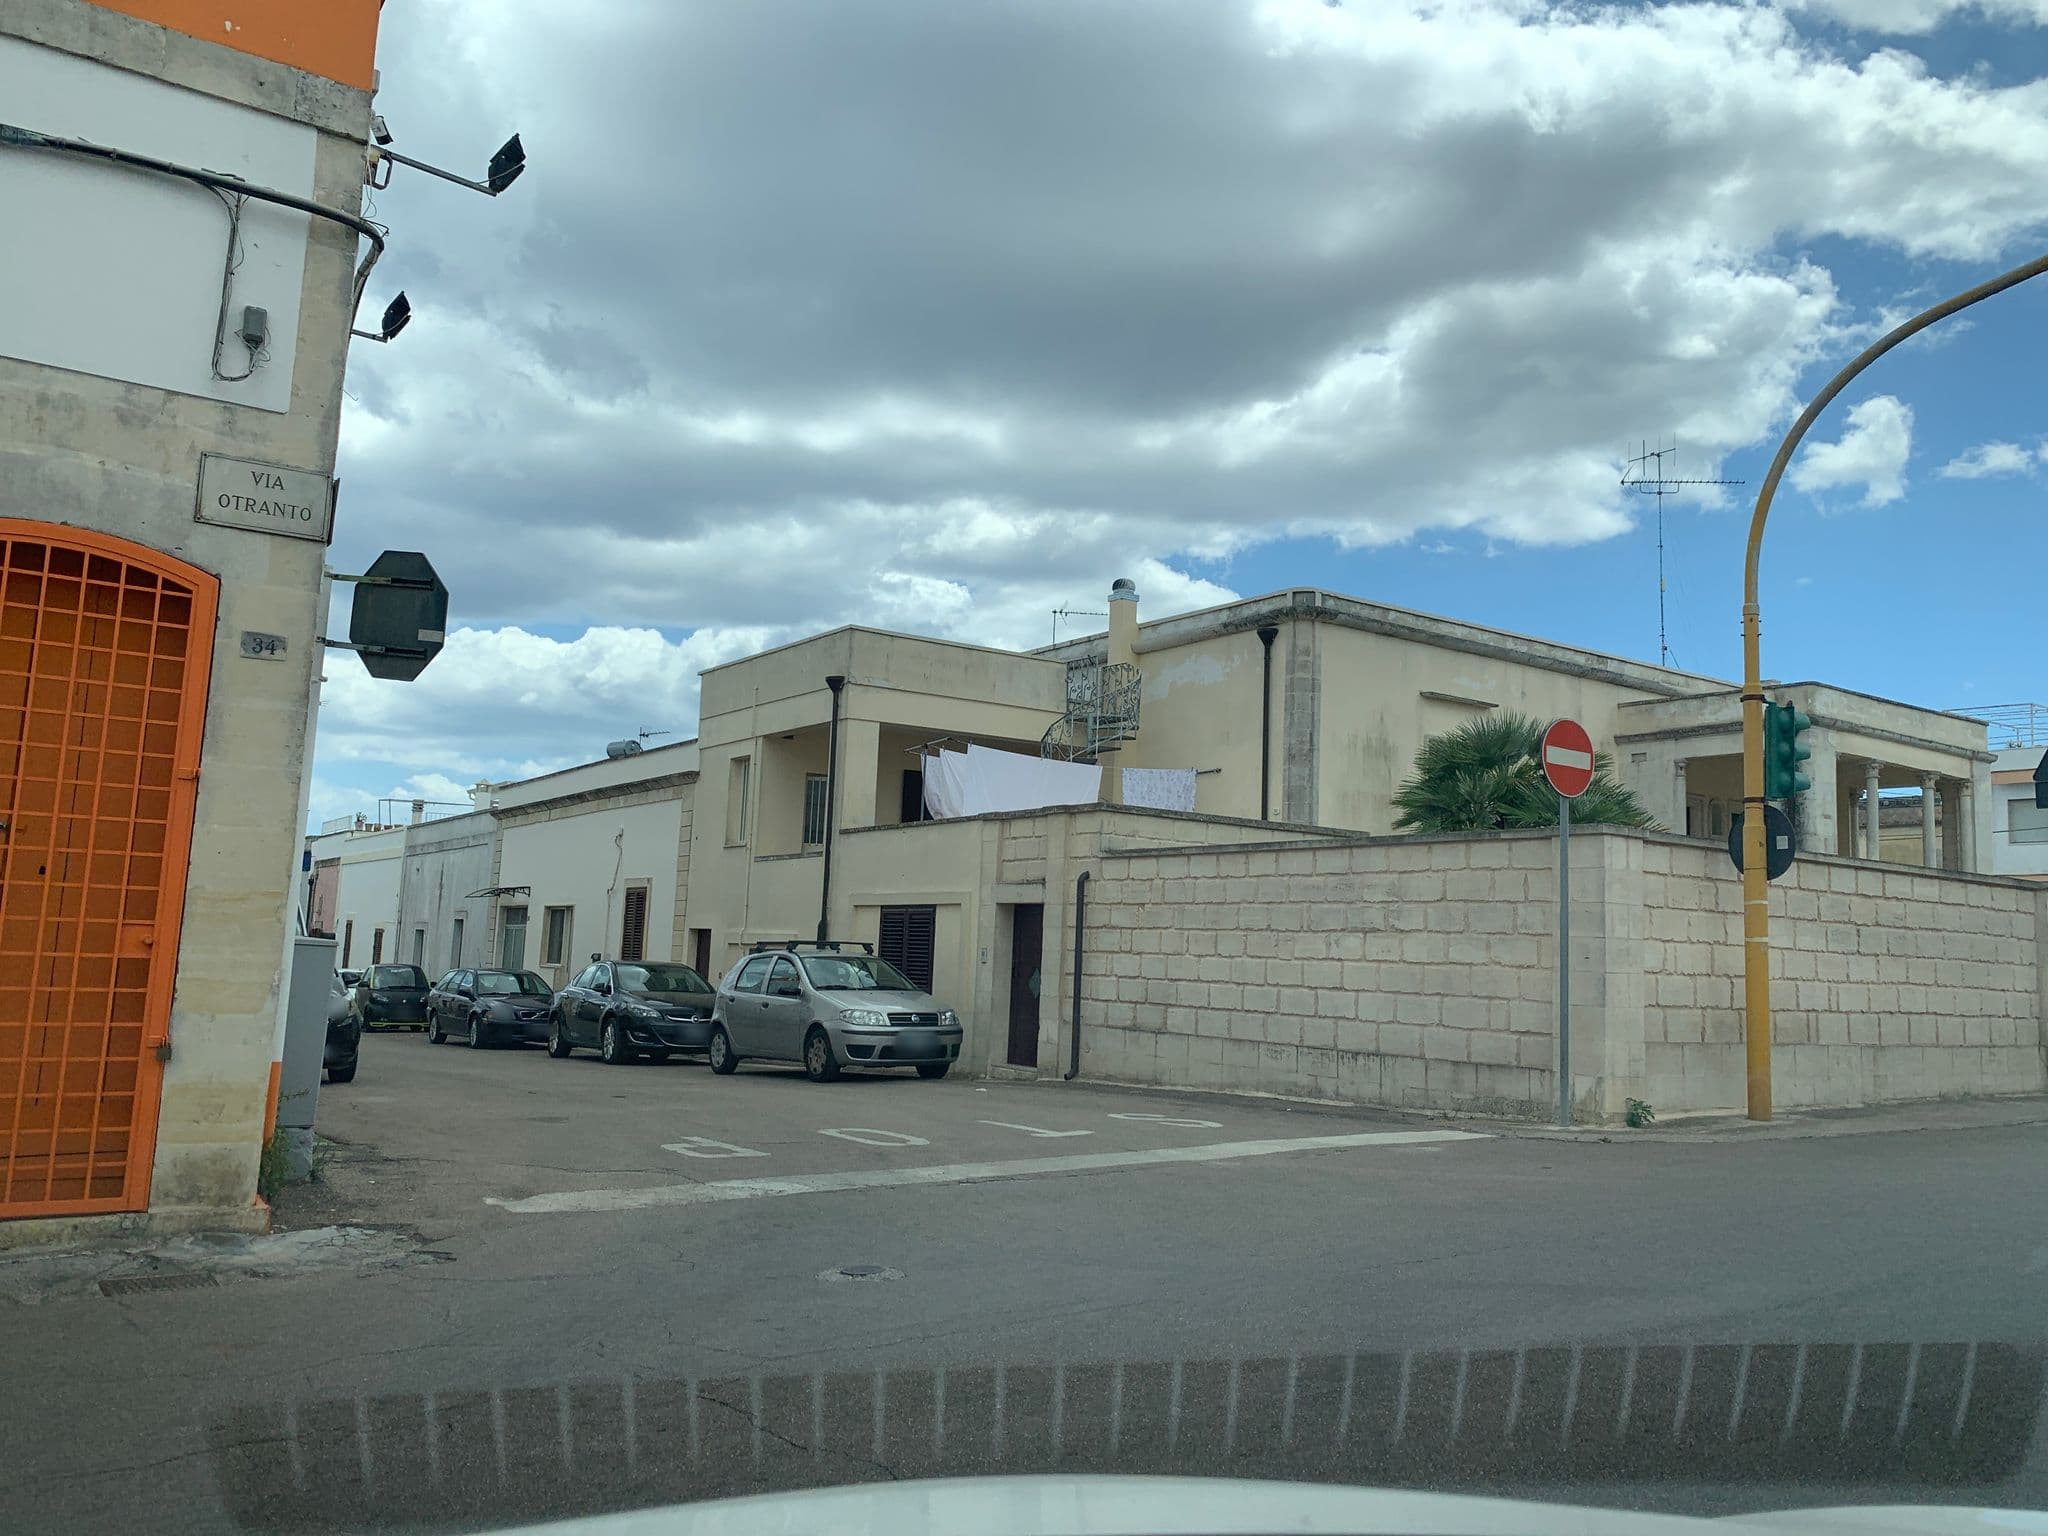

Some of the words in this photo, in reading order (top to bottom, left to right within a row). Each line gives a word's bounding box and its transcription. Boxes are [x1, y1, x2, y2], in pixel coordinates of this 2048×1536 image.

[250, 471, 286, 490] VIA
[218, 494, 311, 521] OTRANTO
[251, 637, 277, 655] 34
[660, 1112, 1223, 1158] STOP
